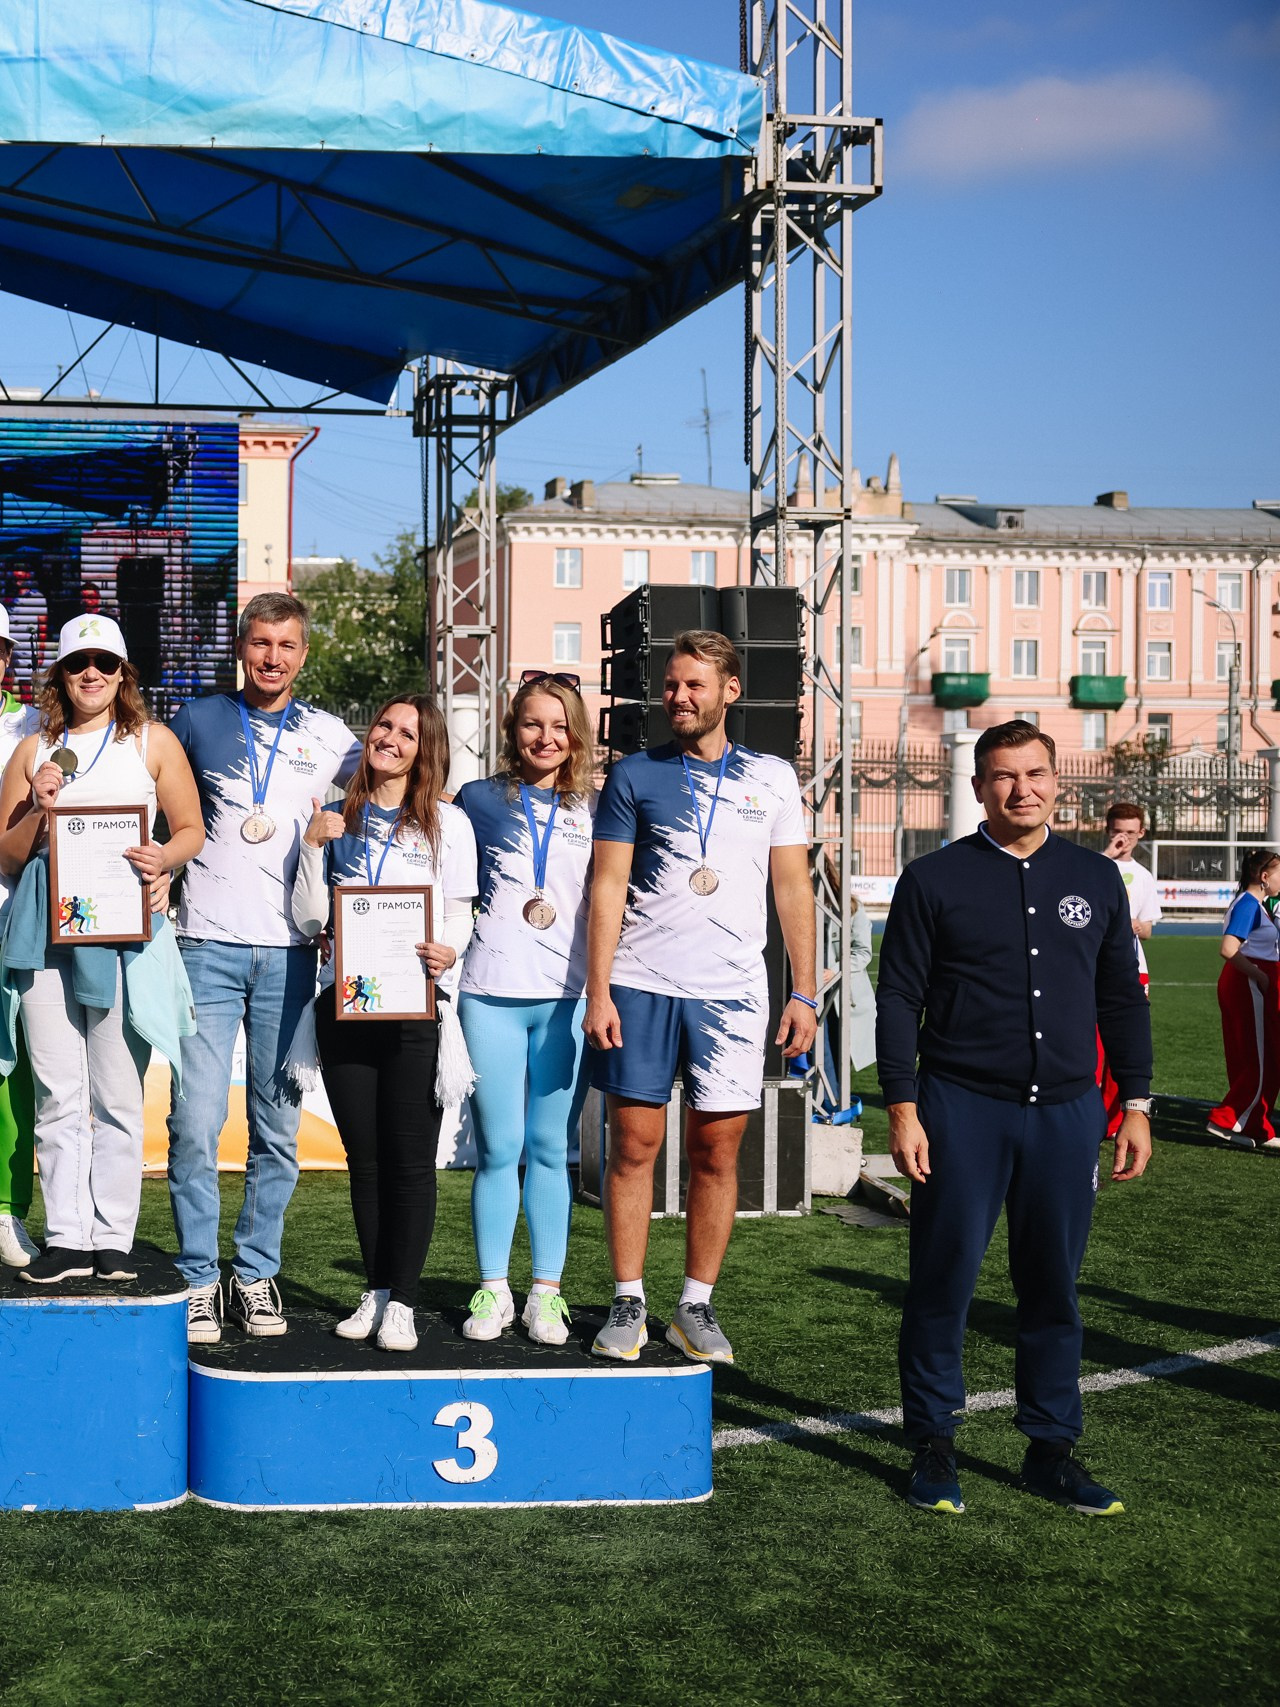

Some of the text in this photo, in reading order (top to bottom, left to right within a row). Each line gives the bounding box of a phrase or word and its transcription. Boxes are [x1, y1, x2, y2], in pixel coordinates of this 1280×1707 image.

[289, 759, 318, 770] КОМОС
[737, 808, 767, 817] КОМОС
[92, 820, 138, 830] ГРАМОТА
[562, 832, 591, 843] КОМОС
[402, 852, 432, 862] КОМОС
[377, 901, 423, 910] ГРАМОТА
[431, 1401, 498, 1484] 3
